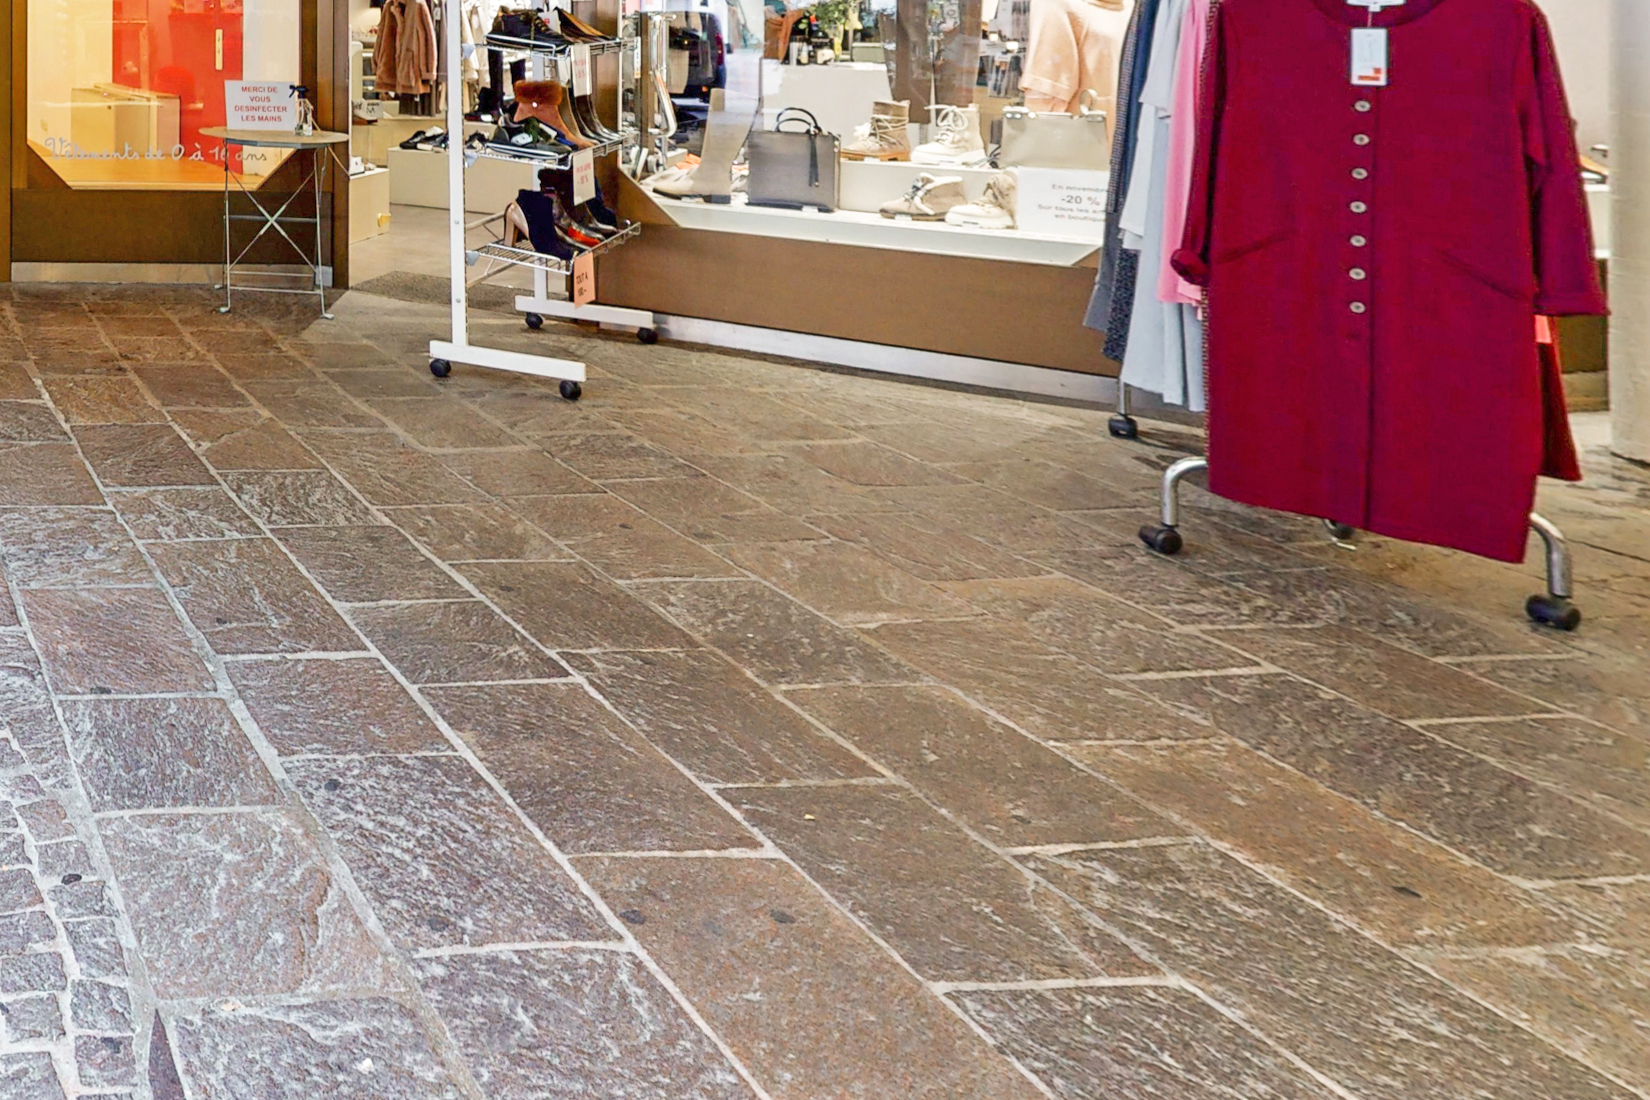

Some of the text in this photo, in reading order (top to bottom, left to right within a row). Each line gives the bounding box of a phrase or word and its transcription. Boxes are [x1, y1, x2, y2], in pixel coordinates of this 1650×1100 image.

[234, 105, 288, 113] DESINFECTER
[44, 137, 140, 160] Vêtements
[145, 144, 165, 160] de
[188, 144, 205, 161] à
[235, 150, 267, 161] ans
[1061, 195, 1101, 206] -20 %
